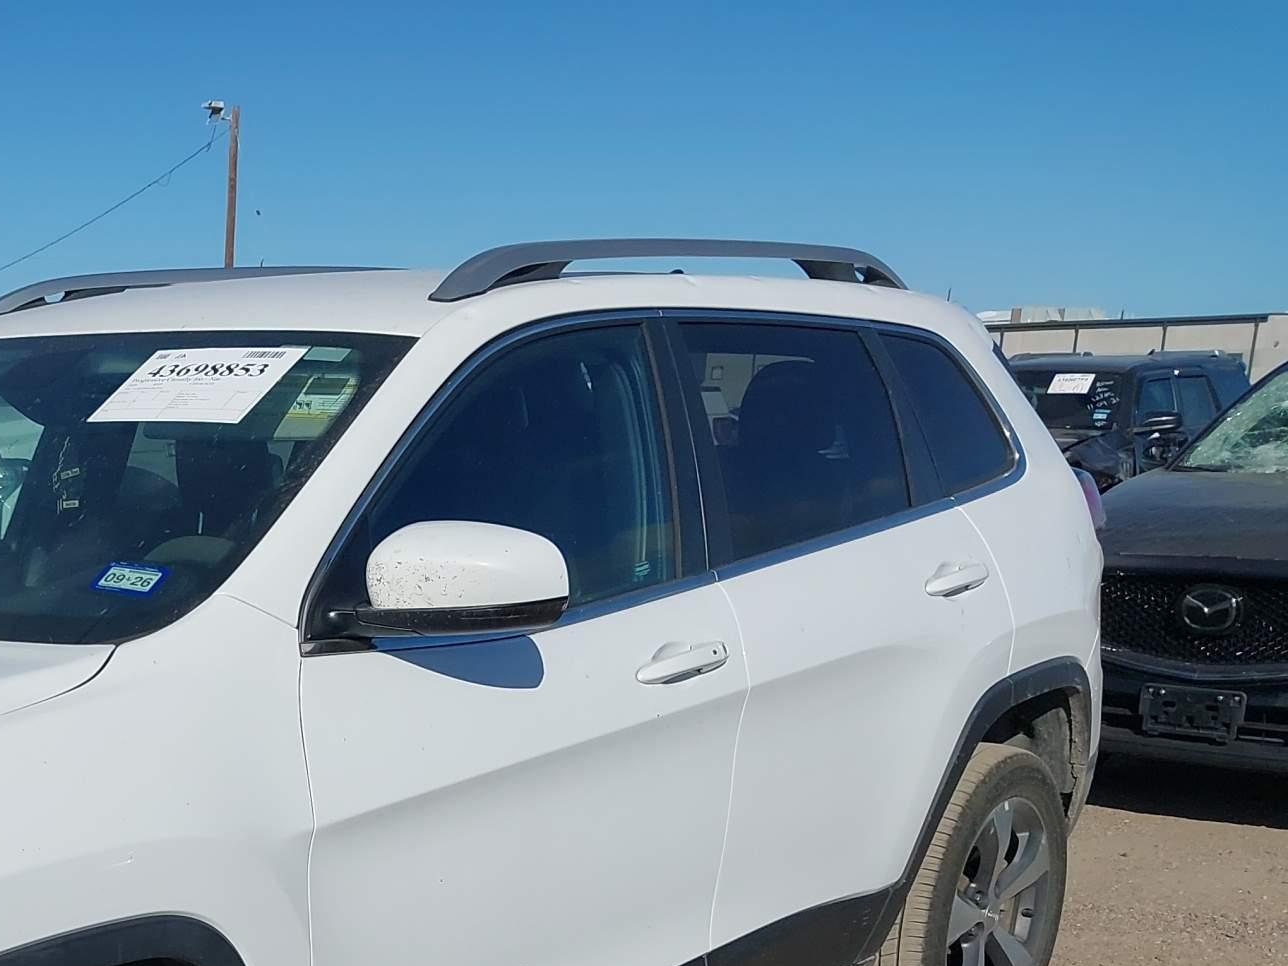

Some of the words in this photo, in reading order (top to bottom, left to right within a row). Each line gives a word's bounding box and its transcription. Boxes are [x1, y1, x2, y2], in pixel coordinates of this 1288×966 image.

[147, 363, 269, 378] 43698853
[103, 573, 126, 584] 09
[129, 576, 153, 588] 26
